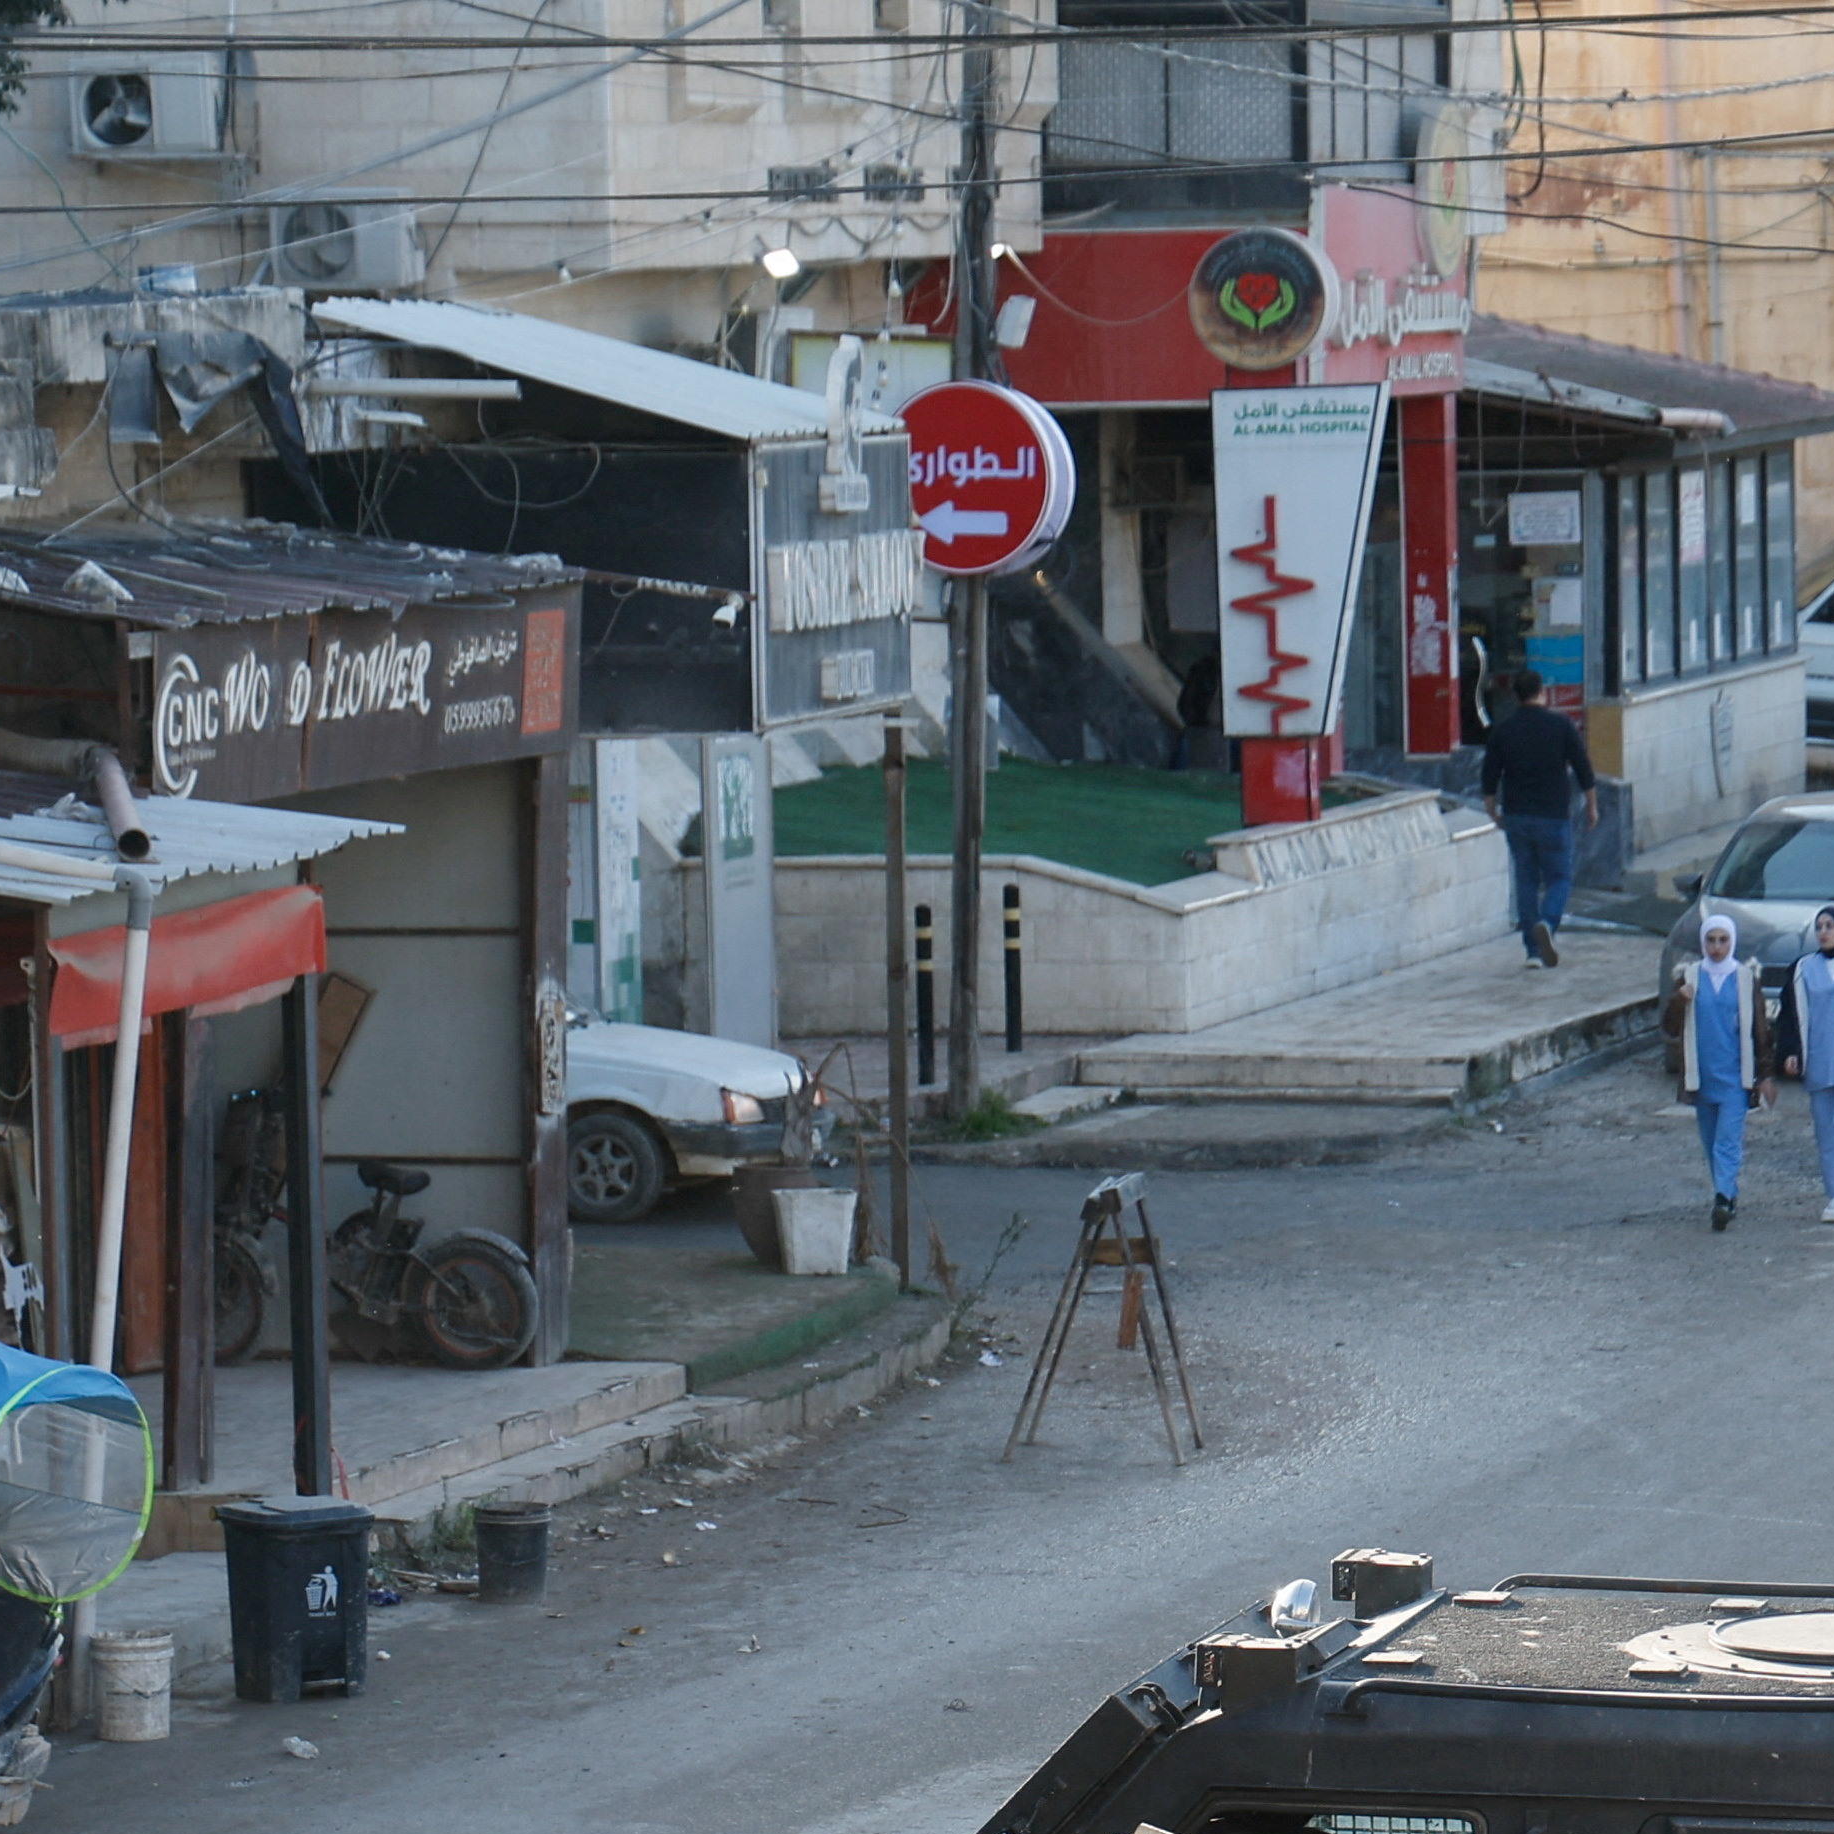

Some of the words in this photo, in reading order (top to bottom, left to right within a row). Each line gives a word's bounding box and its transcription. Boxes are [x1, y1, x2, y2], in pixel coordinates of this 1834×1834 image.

[1422, 352, 1459, 378] HOSPITAL
[1281, 396, 1371, 420] مستشفى
[1233, 421, 1296, 436] AL-AMAL
[1299, 420, 1369, 434] HOSPITAL
[167, 687, 219, 747] CNC
